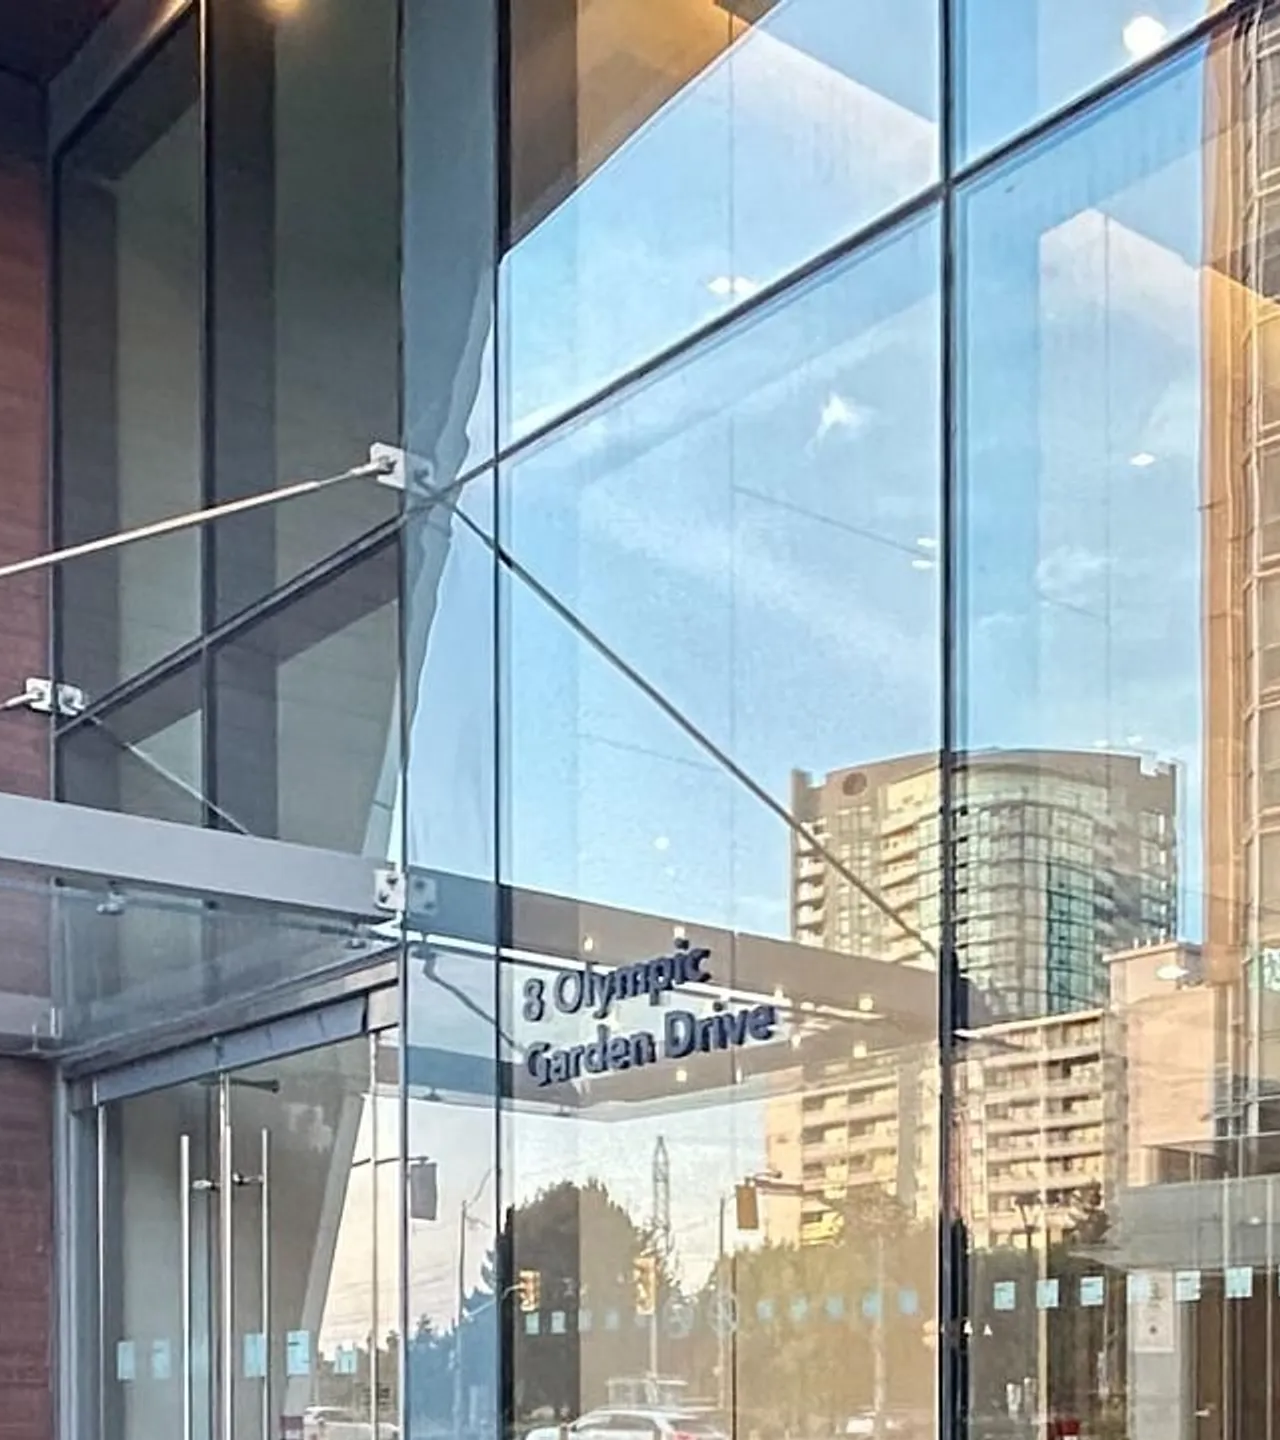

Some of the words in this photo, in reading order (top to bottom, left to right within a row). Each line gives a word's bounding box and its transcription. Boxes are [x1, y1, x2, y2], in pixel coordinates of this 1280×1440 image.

[524, 978, 544, 1021] 8
[555, 937, 711, 1019] Olympic
[527, 1024, 656, 1087] Garden
[665, 1001, 775, 1059] Drive
